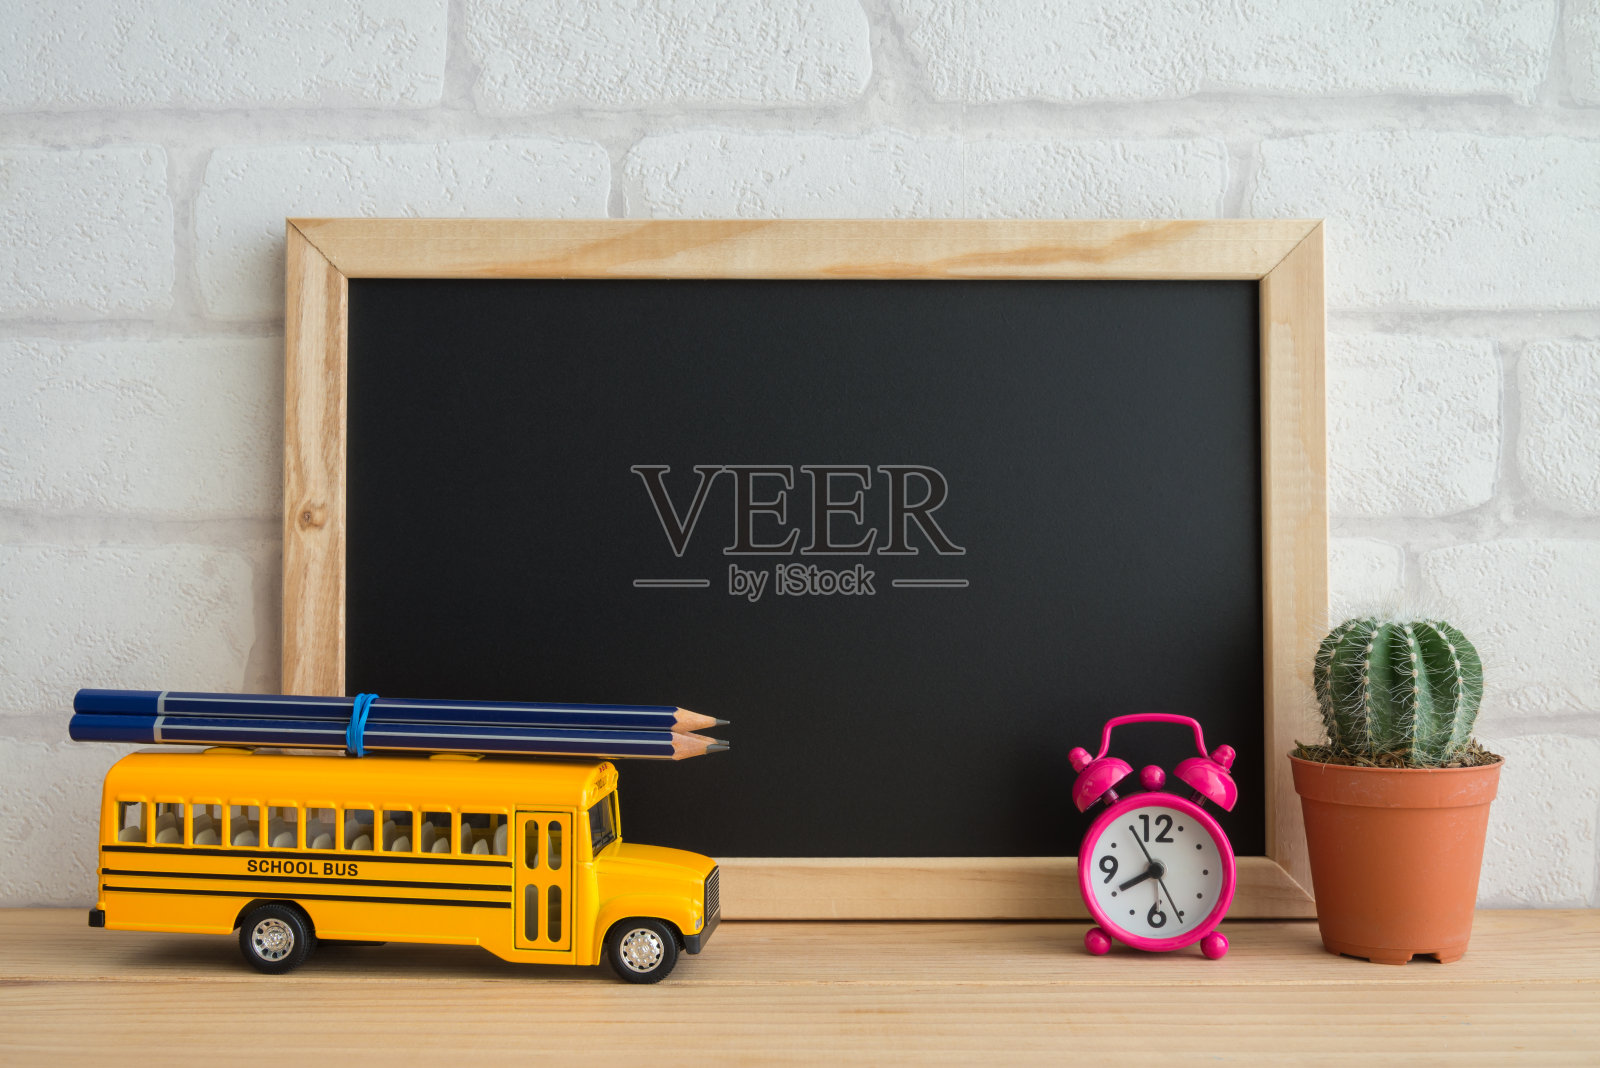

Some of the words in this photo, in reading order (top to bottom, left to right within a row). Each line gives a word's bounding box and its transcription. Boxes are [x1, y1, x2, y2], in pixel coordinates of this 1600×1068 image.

[1138, 814, 1174, 843] 12
[247, 859, 318, 875] SCHOOL
[323, 863, 358, 876] BUS
[1099, 855, 1119, 884] 9
[1147, 900, 1167, 928] 6
